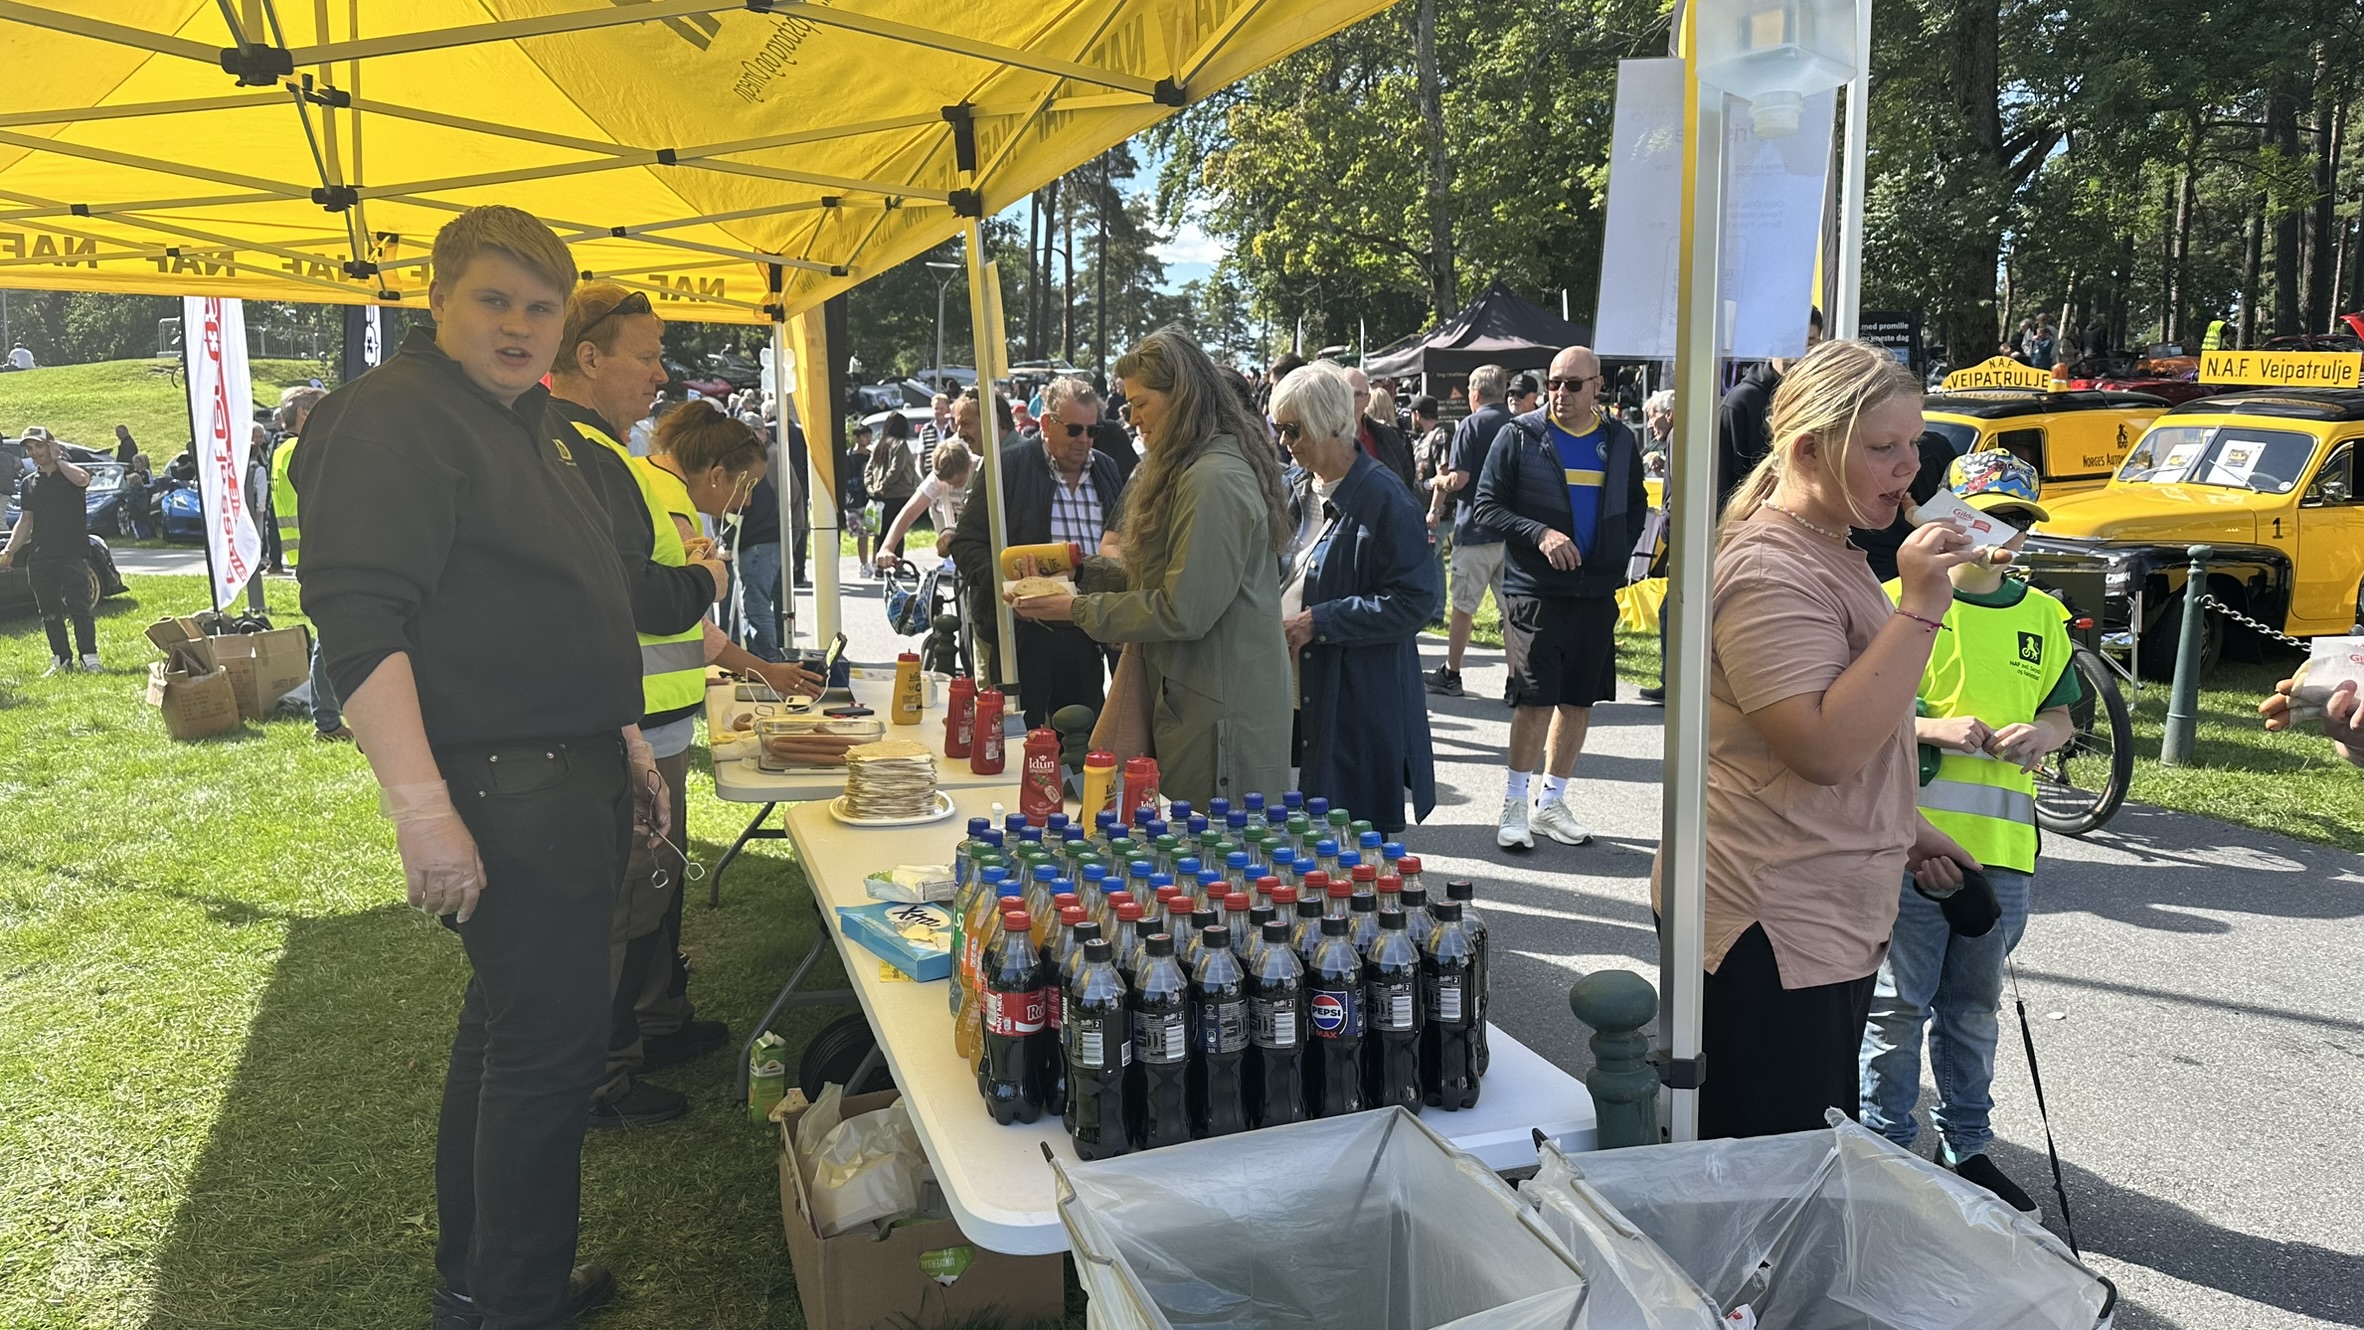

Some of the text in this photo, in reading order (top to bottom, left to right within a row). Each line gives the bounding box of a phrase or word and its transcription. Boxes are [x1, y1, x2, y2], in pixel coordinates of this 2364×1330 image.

[1879, 322, 1909, 331] promille
[1896, 333, 1910, 343] dag
[2206, 357, 2352, 385] N.A.F. Veipatrulje
[1951, 371, 2050, 388] VEIPATRULJE
[2082, 455, 2105, 468] NORGES
[1953, 508, 1975, 521] Gilde
[2272, 517, 2283, 539] 1
[1028, 757, 1055, 769] Idun
[1312, 1005, 1341, 1017] PEPSI
[1315, 1029, 1338, 1039] MAX
